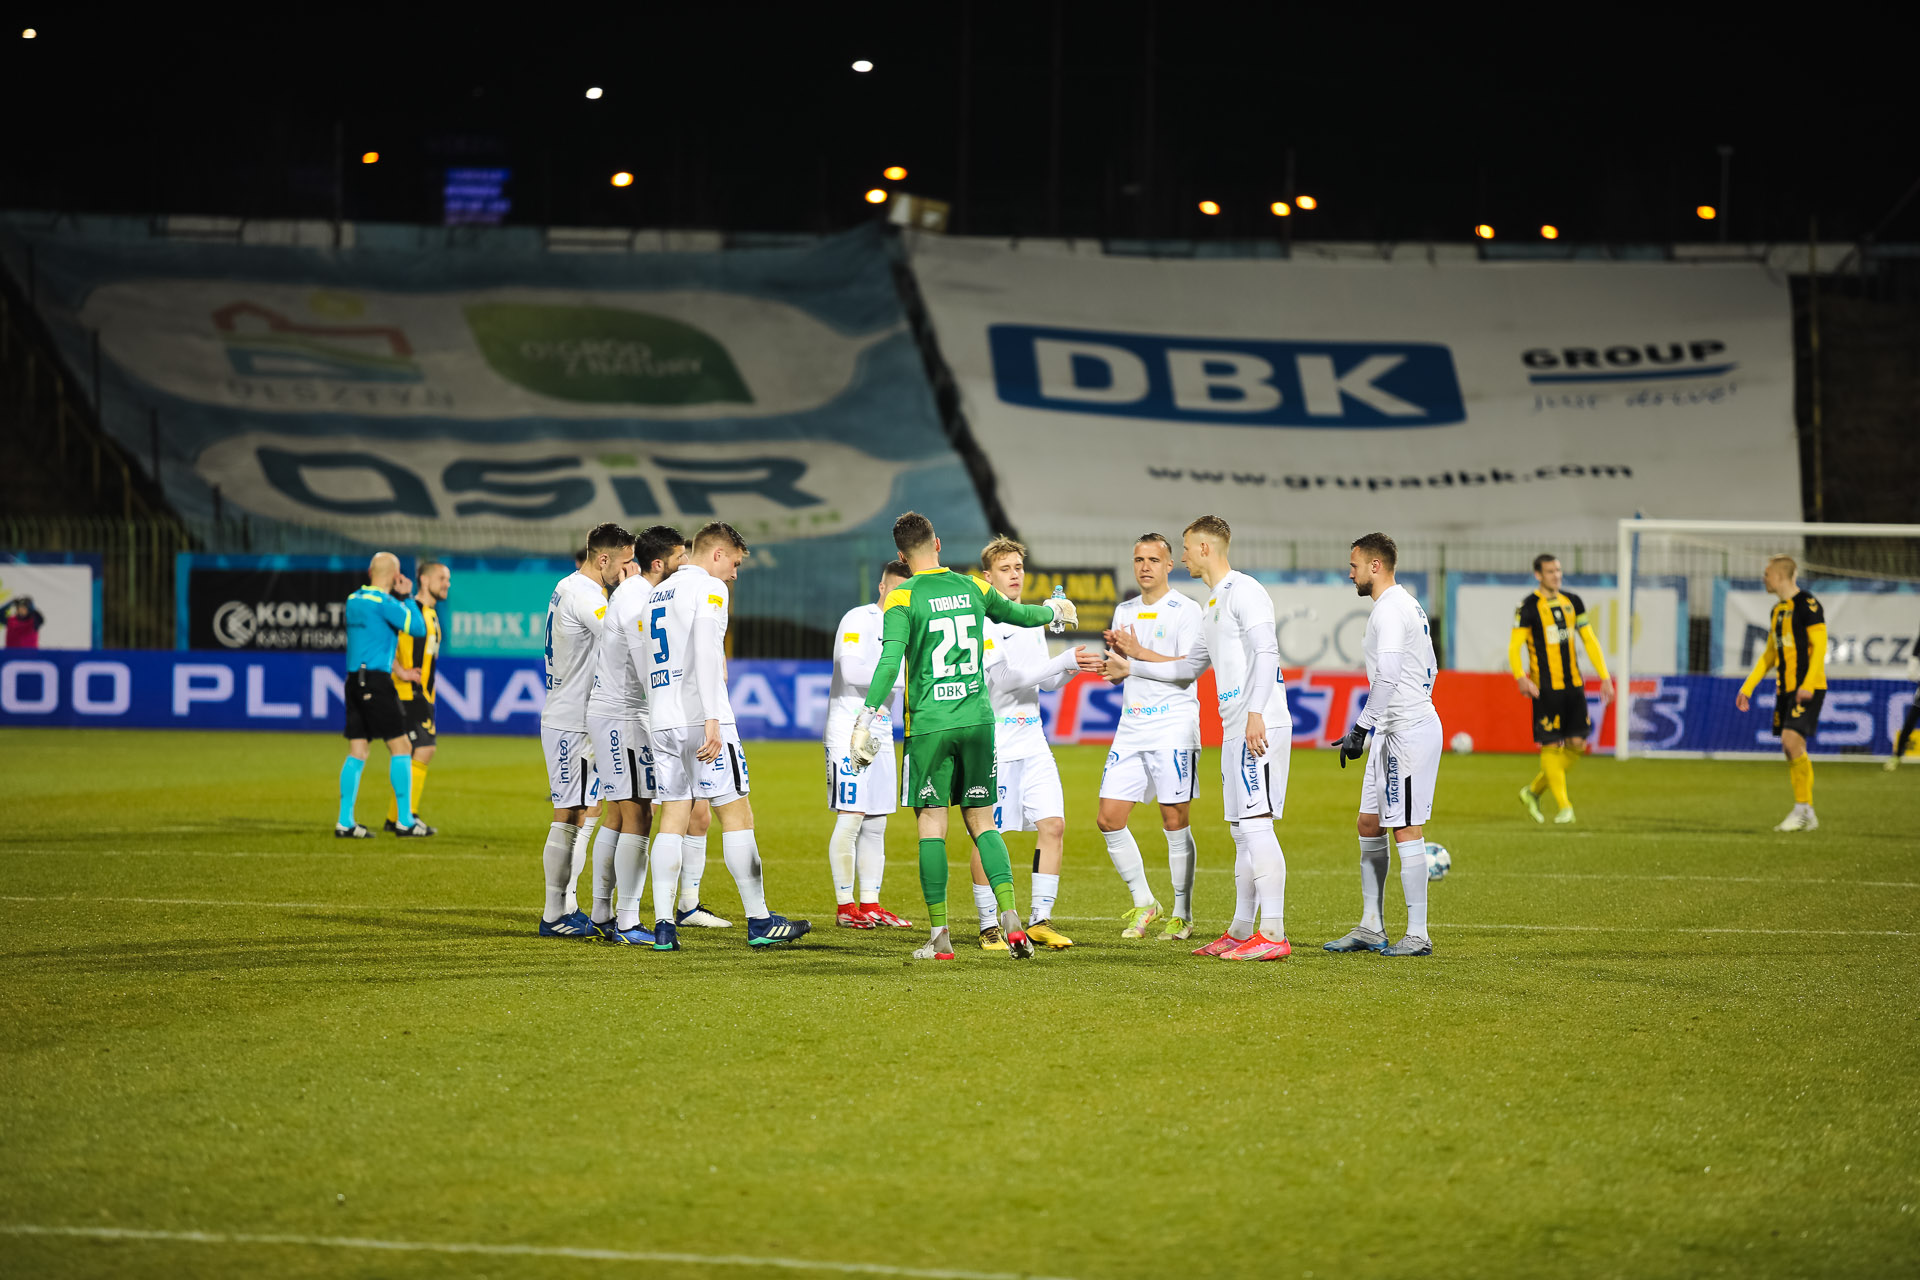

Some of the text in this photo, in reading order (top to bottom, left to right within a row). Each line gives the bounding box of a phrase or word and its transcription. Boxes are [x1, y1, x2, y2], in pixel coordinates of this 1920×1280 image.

[1520, 338, 1728, 370] GROUP
[1033, 337, 1430, 418] DBK
[1146, 463, 1634, 492] www.grupadbk.com
[256, 602, 346, 627] KON-T
[928, 594, 972, 613] TOBIASZ
[452, 611, 524, 637] max
[650, 607, 669, 665] 5
[929, 614, 978, 678] 25
[172, 663, 347, 718] PLN
[652, 671, 669, 687] DBK
[937, 684, 964, 698] DBK
[1040, 673, 1124, 736] TS
[1286, 675, 1370, 742] ST
[645, 767, 656, 790] 6
[1179, 750, 1188, 778] DACHL
[1246, 748, 1260, 791] DACHLA
[590, 777, 600, 799] 4
[840, 781, 857, 804] 13
[1390, 756, 1399, 803] DACHLAND
